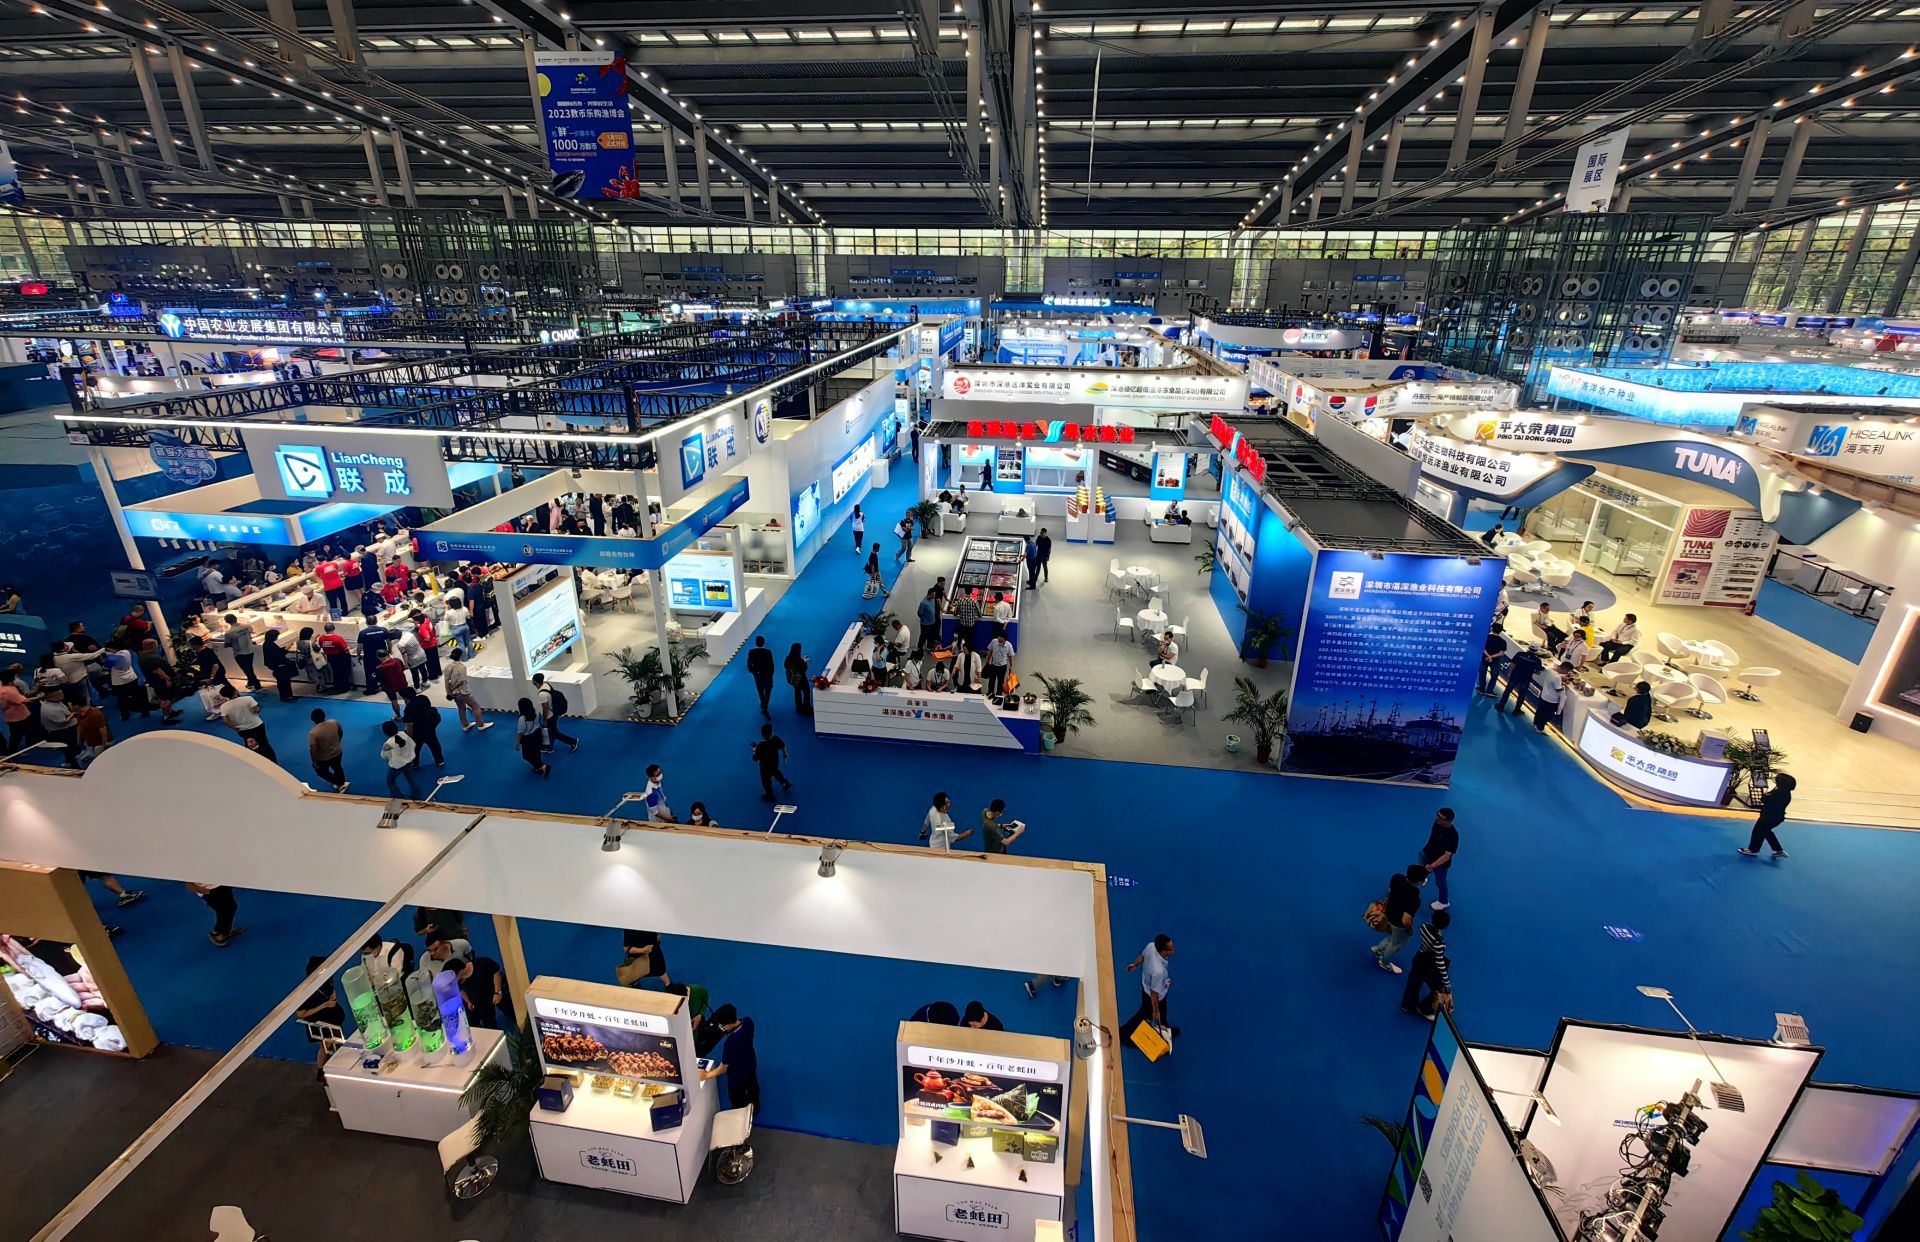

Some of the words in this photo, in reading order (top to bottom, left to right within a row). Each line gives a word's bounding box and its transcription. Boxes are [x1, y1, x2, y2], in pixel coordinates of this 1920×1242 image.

[553, 139, 578, 150] 1000
[1588, 153, 1608, 168] 国际
[1584, 169, 1603, 182] 展区
[184, 318, 343, 336] 中国农业发展集团有限公司
[552, 328, 580, 341] CNADC
[975, 381, 1070, 389] 深圳市深港远洋实业有限公司
[1580, 381, 1636, 402] 海洋水产种业
[706, 425, 734, 444] LianCheng
[1499, 422, 1577, 438] 平太荣集团
[1849, 430, 1914, 440] HISEALINK
[707, 436, 735, 468] 联成
[1844, 444, 1884, 455] 海实利
[331, 452, 404, 468] LianCheng
[1674, 447, 1739, 484] TUNA
[336, 467, 409, 496] 联成
[1683, 540, 1713, 550] TUNA
[1365, 581, 1482, 594] 深圳市湛深渔业科技有限公司
[1457, 1079, 1470, 1107] FOR
[1466, 1095, 1480, 1126] INTO
[1466, 1115, 1489, 1168] SAILING
[586, 1155, 630, 1171] 老蚝田
[1446, 1139, 1465, 1182] BETTER
[1456, 1164, 1472, 1199] FROM
[953, 1208, 1002, 1224] 老蚝田
